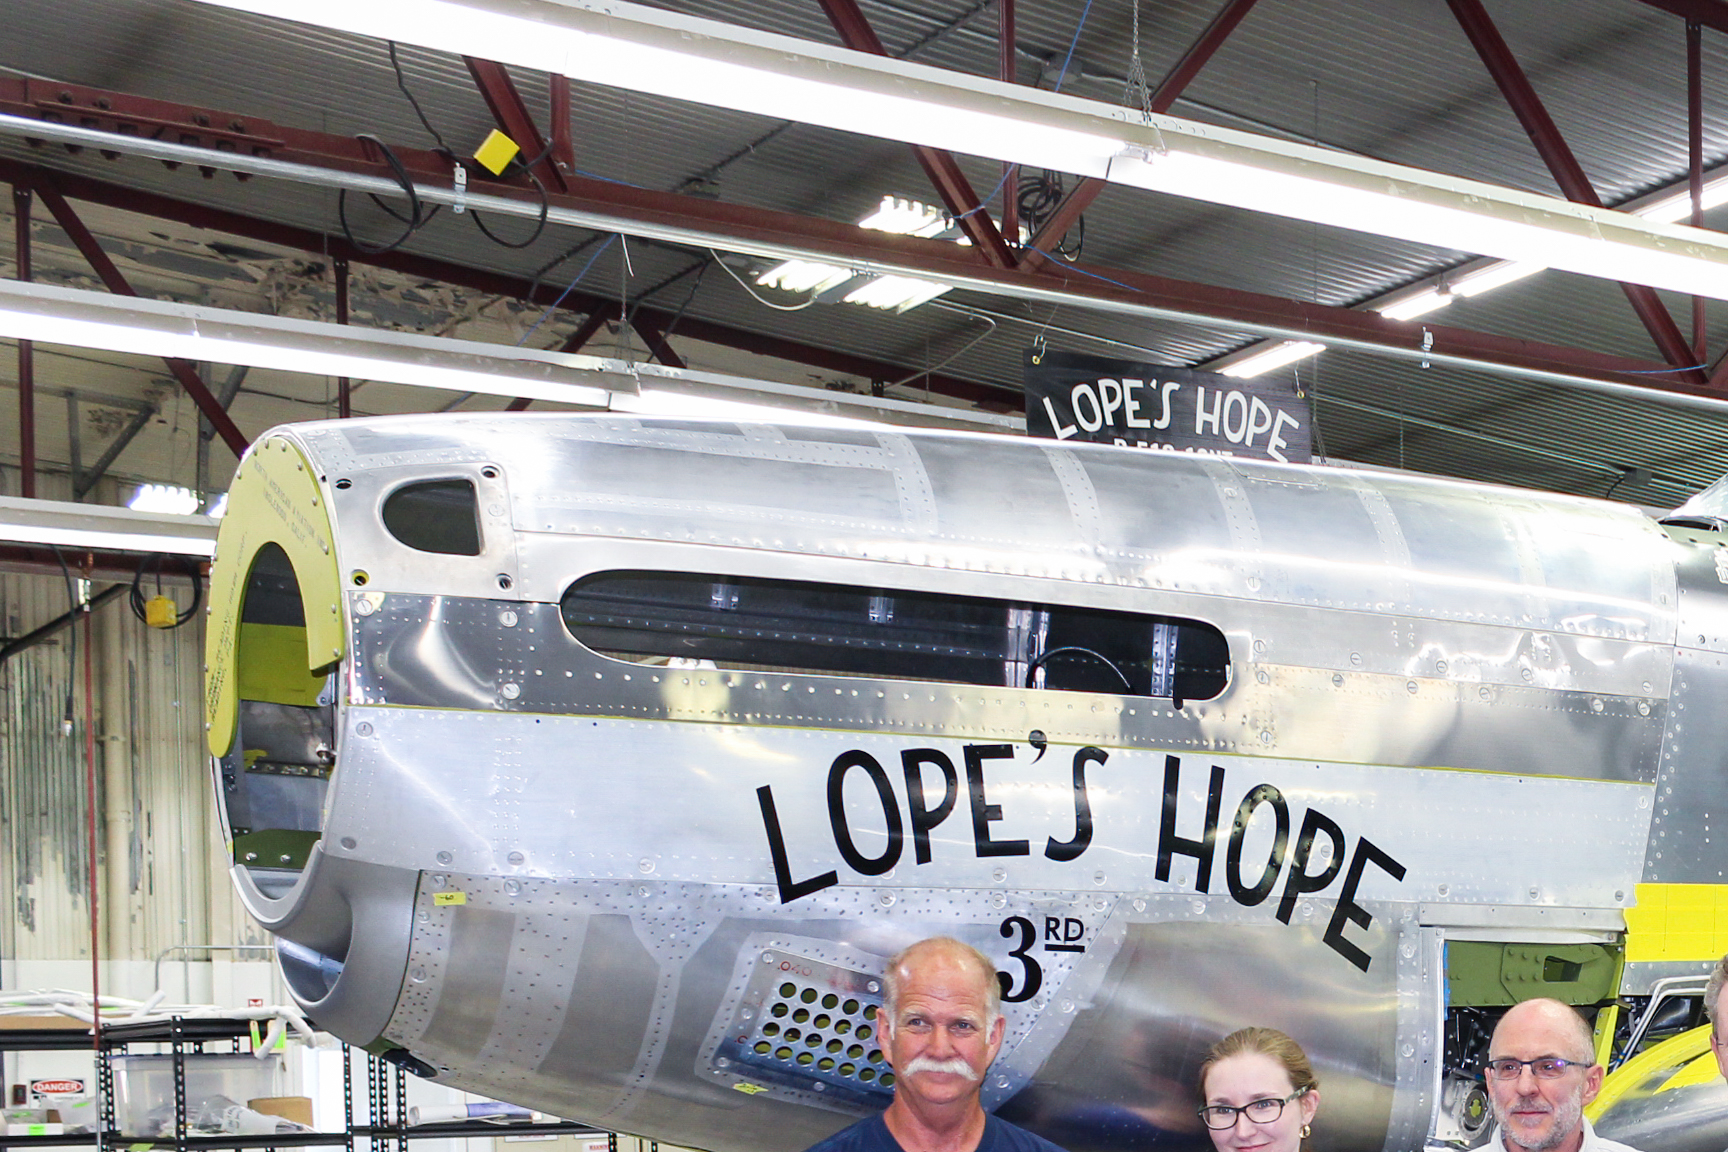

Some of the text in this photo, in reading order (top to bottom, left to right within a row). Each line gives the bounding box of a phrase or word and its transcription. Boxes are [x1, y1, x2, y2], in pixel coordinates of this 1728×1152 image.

[1042, 378, 1300, 463] LOPE'S HOPE
[756, 729, 1407, 974] LOPE'S HOPE
[37, 1083, 79, 1091] DANGER
